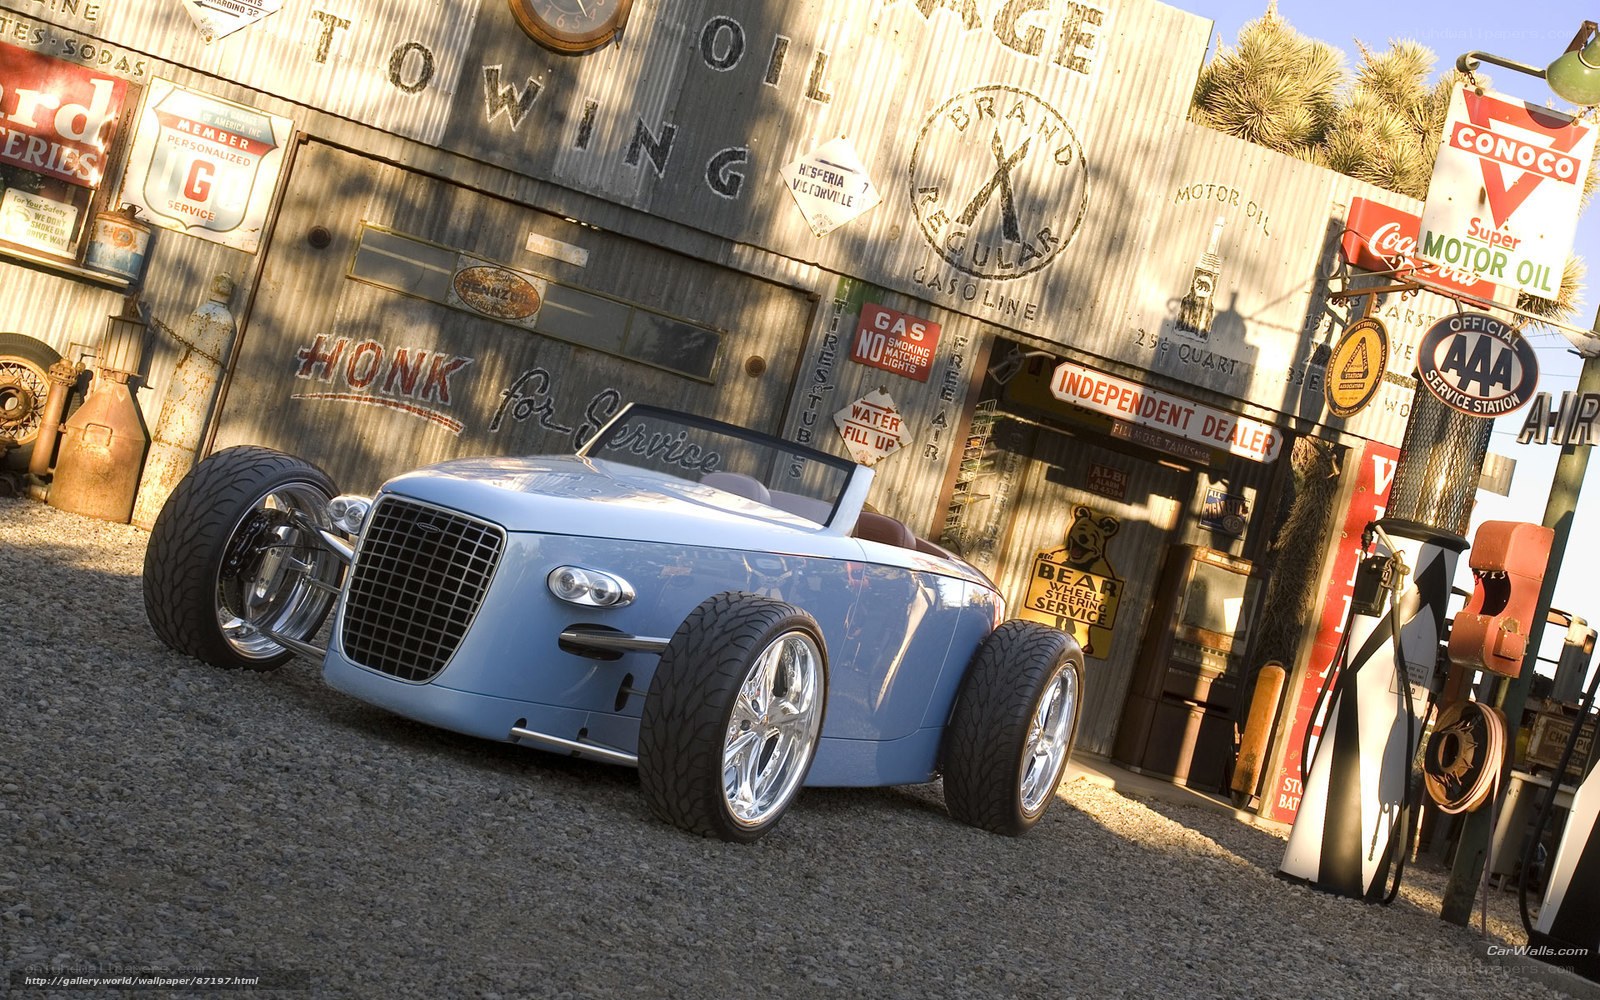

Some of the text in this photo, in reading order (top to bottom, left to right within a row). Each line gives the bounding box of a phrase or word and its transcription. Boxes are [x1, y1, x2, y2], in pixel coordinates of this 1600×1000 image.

[247, 8, 259, 18] 32
[62, 38, 146, 77] SODAS
[698, 15, 833, 105] OIL
[311, 9, 750, 200] TOWING
[176, 119, 250, 151] MEMBER
[947, 96, 1073, 166] BRAND
[167, 135, 252, 167] PERSONALIZED
[1457, 127, 1574, 178] CONOCO
[798, 163, 844, 188] HESPERIA
[14, 195, 68, 217] For Your Safety
[34, 212, 45, 222] WE
[167, 199, 215, 221] SERVICE
[1174, 184, 1270, 237] MOTOR OIL
[31, 221, 54, 234] SMOKE
[49, 235, 66, 246] WAY
[918, 186, 1059, 270] REGULAR
[1467, 217, 1521, 251] Super
[1423, 231, 1552, 292] MOTOR OIL
[913, 266, 1037, 321] GASOLINE
[814, 298, 847, 384] TIRES
[874, 311, 926, 342] GAS
[1449, 317, 1520, 352] OFFICIAL
[855, 328, 886, 363] NO
[885, 347, 927, 368] MATCHES
[887, 337, 931, 358] SMOKING
[1178, 343, 1239, 376] QUART
[296, 333, 474, 406] HONK
[882, 355, 916, 374] LIGHTS
[939, 334, 968, 402] FREE
[1440, 333, 1512, 397] AAA
[1426, 369, 1520, 413] SERVICE STATION
[488, 367, 722, 475] for Service
[851, 404, 900, 432] WATER
[1058, 370, 1276, 456] INDEPENDENT DEALER
[1516, 391, 1600, 446] AIR
[843, 425, 895, 452] FILL UP
[923, 409, 948, 462] AIR
[1091, 466, 1127, 486] ALBI
[1208, 490, 1221, 500] ALL
[1038, 563, 1117, 597] BEAR
[1035, 597, 1107, 625] SERVICE
[1045, 590, 1107, 613] STEERING
